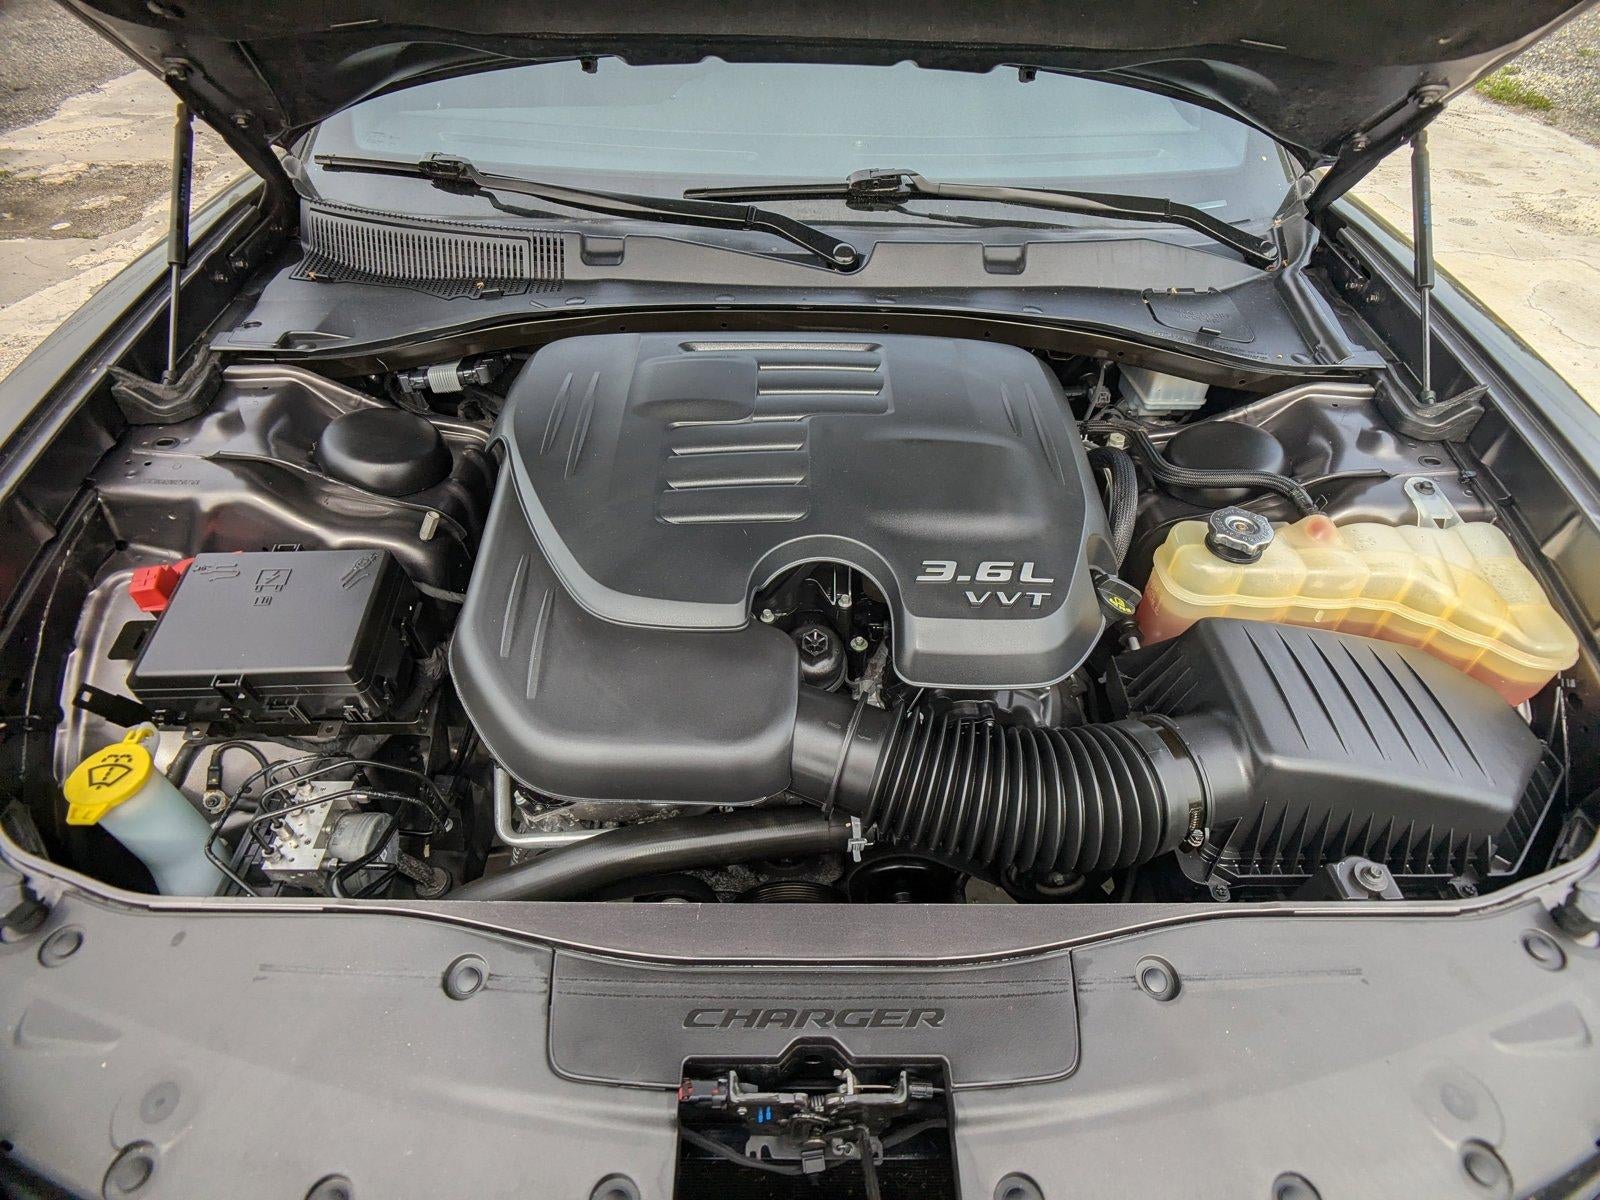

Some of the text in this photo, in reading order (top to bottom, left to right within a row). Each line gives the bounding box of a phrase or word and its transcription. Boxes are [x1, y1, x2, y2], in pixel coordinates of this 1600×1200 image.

[915, 560, 1055, 584] 3.6L
[965, 591, 1052, 608] VVT
[683, 1008, 946, 1029] CHARGER
